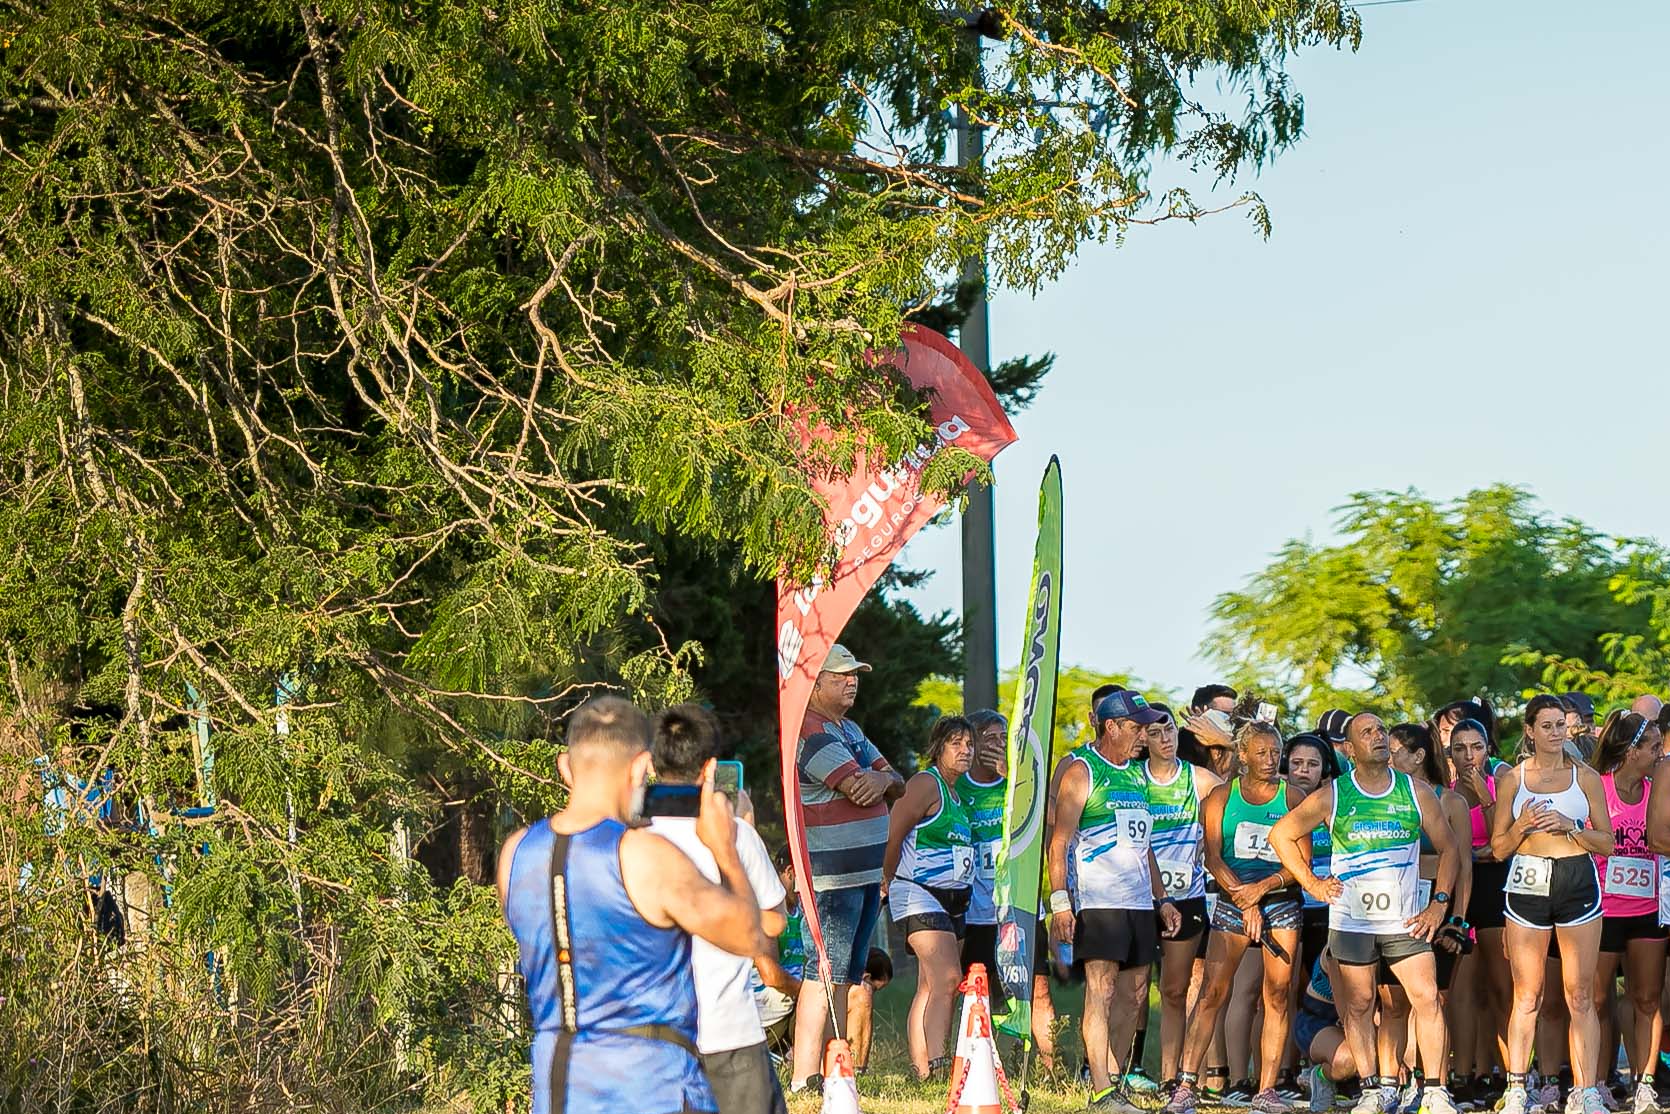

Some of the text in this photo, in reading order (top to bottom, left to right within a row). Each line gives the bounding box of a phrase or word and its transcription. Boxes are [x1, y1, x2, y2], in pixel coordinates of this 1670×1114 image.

[853, 492, 926, 568] SEGUROS
[1127, 819, 1148, 840] 59
[983, 852, 995, 870] 1
[1512, 865, 1537, 886] 58
[1611, 866, 1651, 888] 525
[1361, 892, 1391, 912] 90
